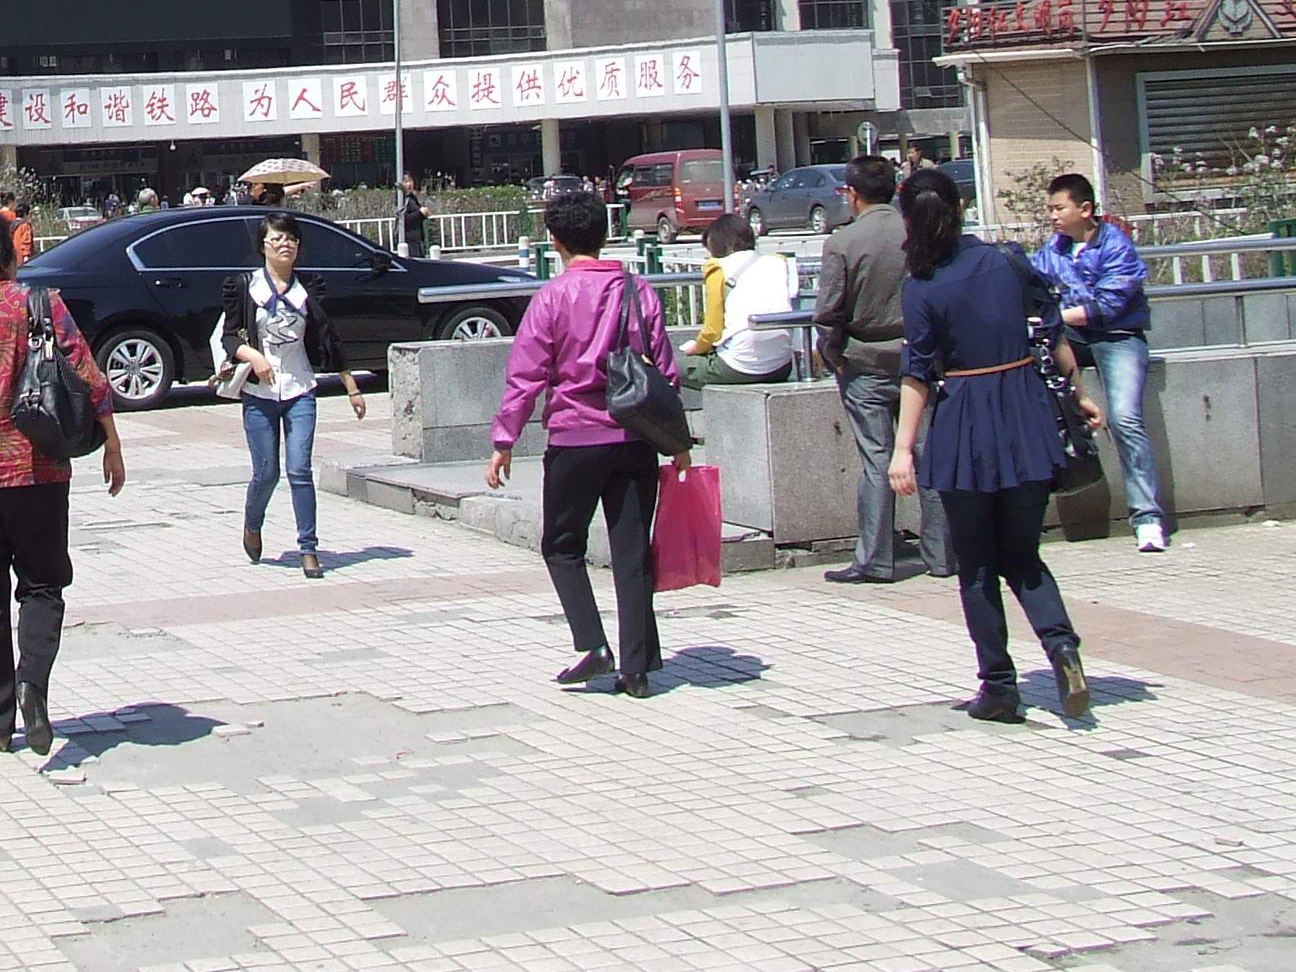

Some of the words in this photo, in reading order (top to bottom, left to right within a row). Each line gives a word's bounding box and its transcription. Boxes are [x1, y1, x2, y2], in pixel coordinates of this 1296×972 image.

[248, 56, 700, 116] 为人民群众提供优质服务
